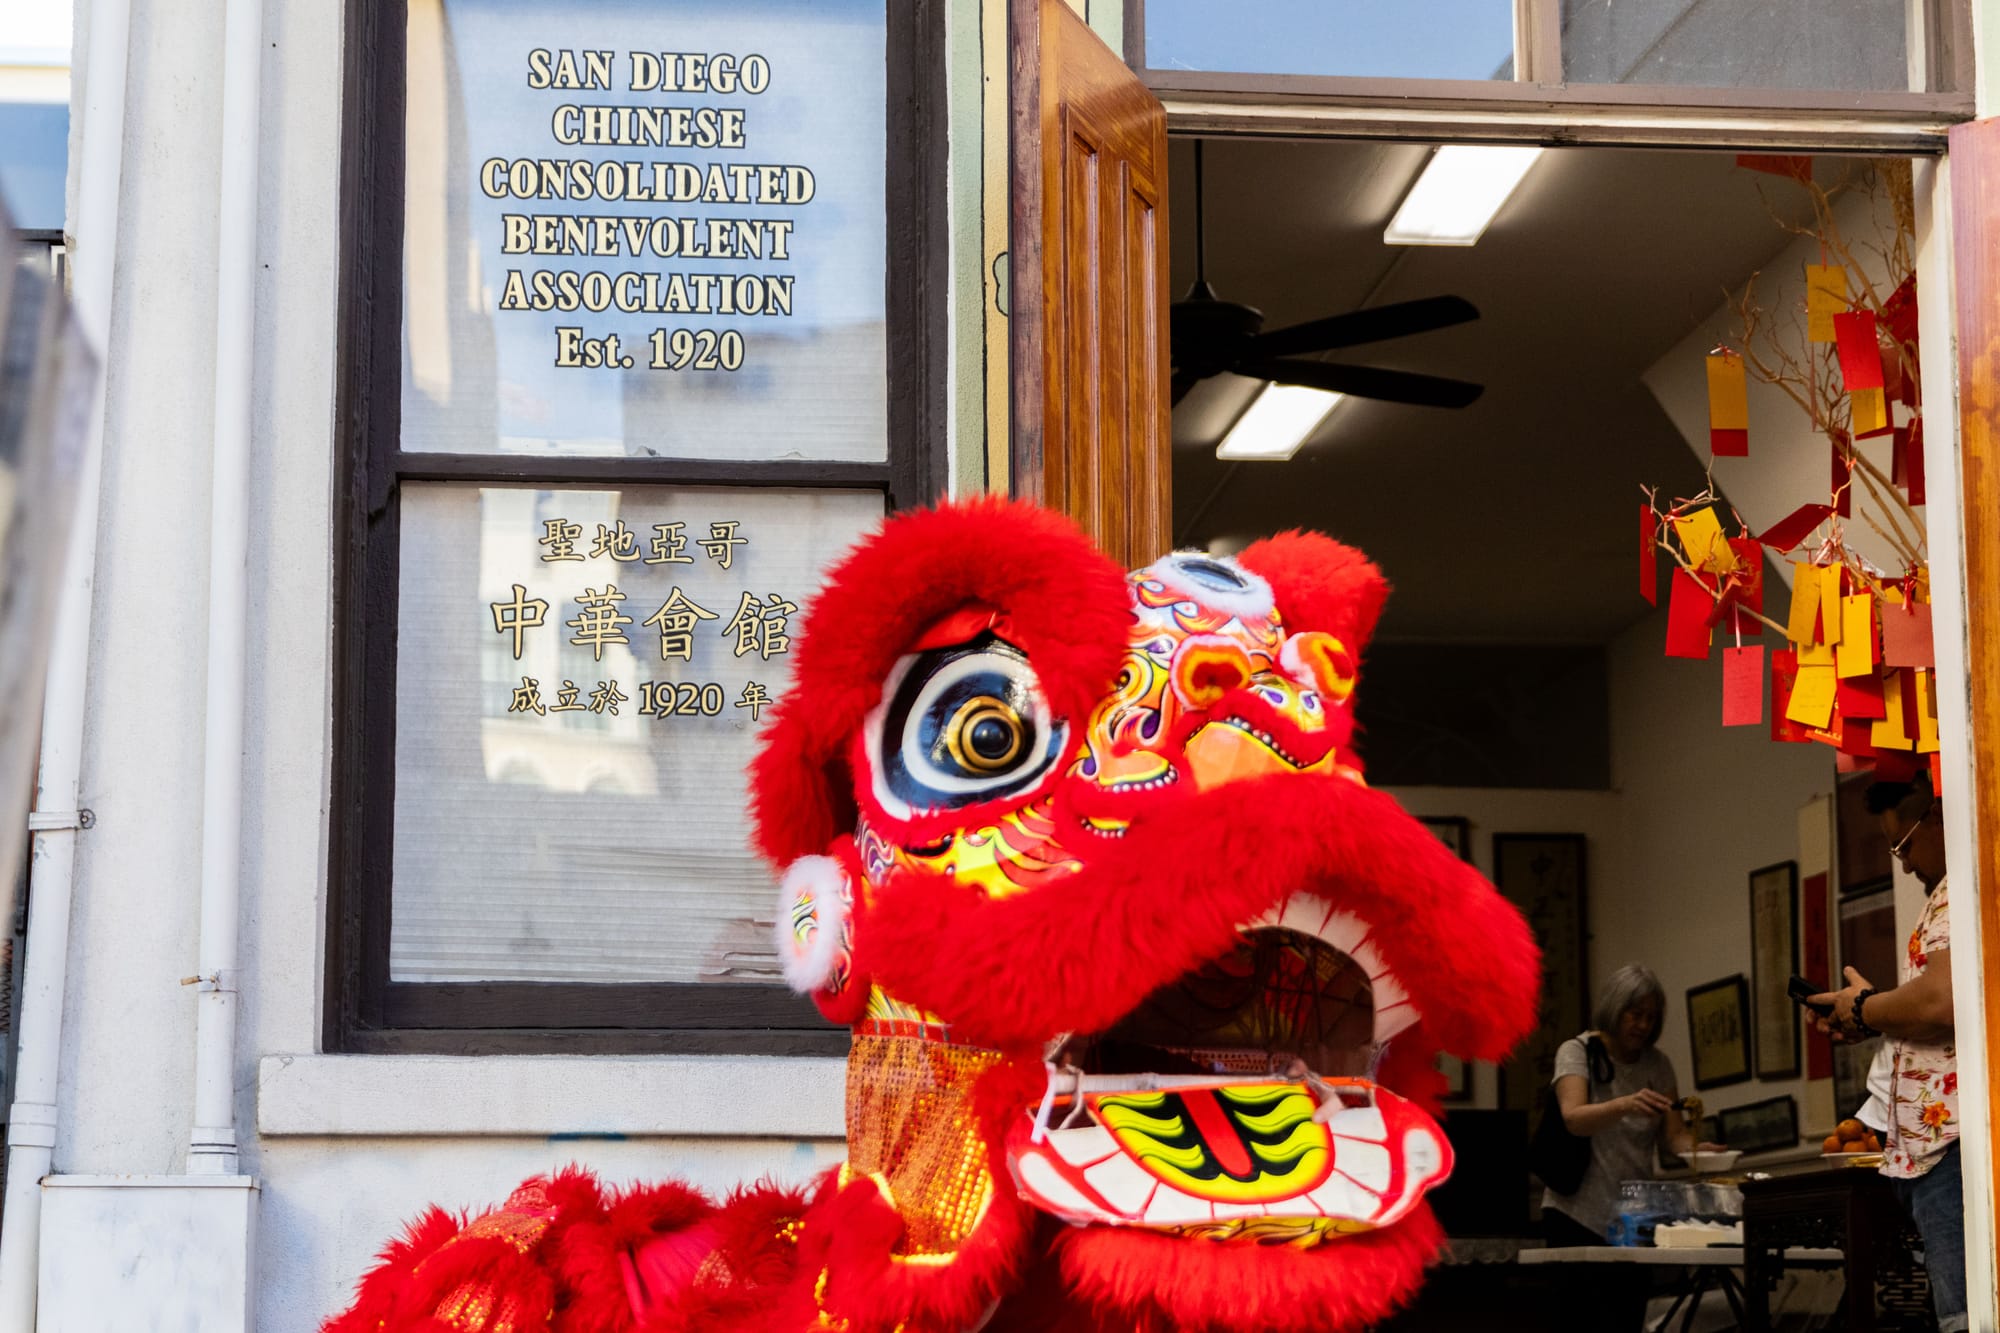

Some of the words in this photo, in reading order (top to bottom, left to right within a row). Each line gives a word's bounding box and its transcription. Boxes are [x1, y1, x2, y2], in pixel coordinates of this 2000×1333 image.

[527, 48, 615, 91] SAN
[629, 52, 771, 95] DIEGO
[552, 104, 746, 148] CHINESE
[480, 157, 816, 205] CONSOLIDATED
[502, 213, 794, 260] BENEVOLENT
[499, 269, 795, 316] ASSOCIATION
[554, 327, 634, 370] Est.
[649, 328, 745, 372] 1920
[538, 518, 749, 570] 聖地亞哥
[490, 583, 799, 662] 中華會館
[508, 676, 629, 717] 成立於
[638, 681, 725, 720] 1920
[734, 681, 773, 721] 年
